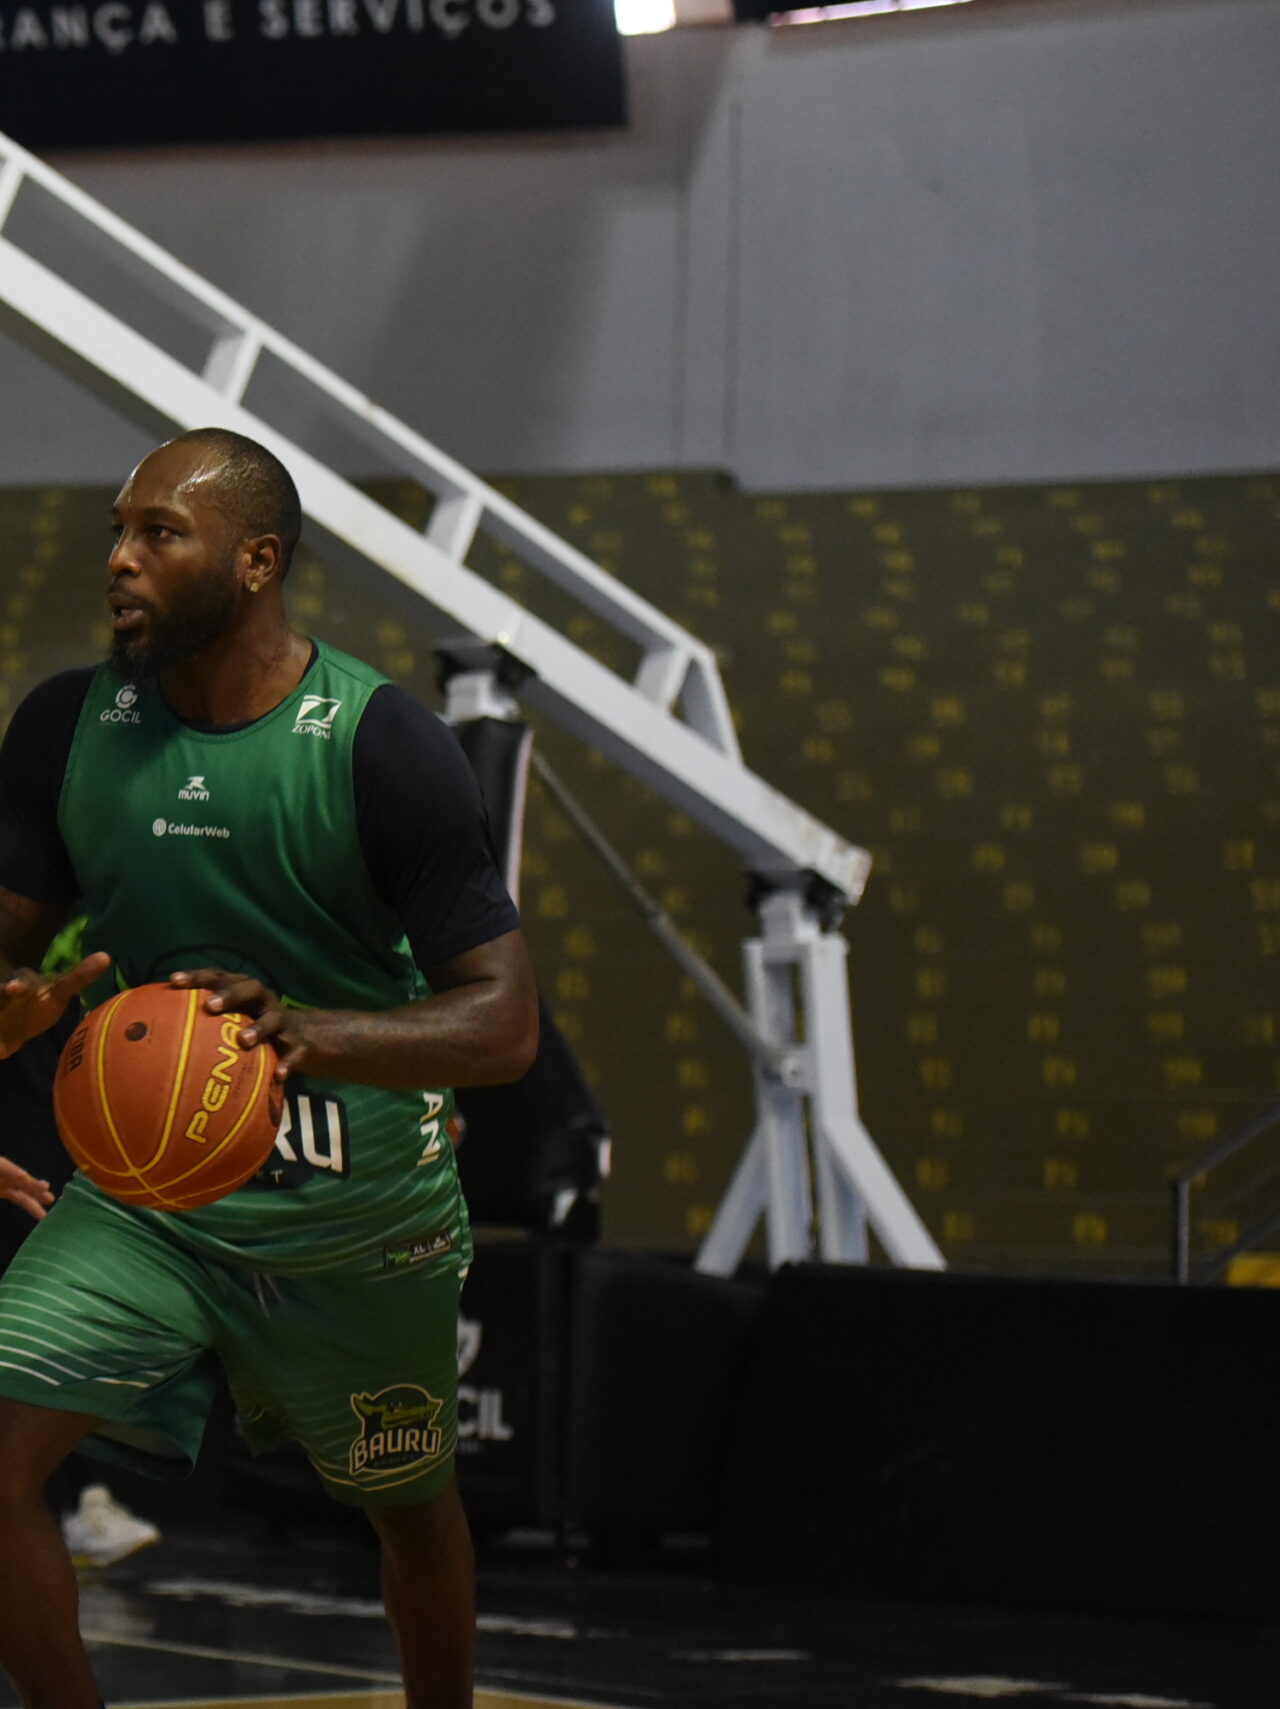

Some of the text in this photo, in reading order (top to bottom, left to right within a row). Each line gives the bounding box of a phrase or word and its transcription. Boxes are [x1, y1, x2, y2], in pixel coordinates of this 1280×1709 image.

[202, 0, 233, 41] E
[257, 0, 554, 39] SERVIÇOS
[100, 709, 141, 724] GOCIL
[291, 724, 332, 740] ZOPON
[178, 789, 210, 801] muvin
[168, 822, 230, 839] CelularWeb
[185, 1012, 242, 1145] PENA
[353, 1427, 438, 1472] BAURU
